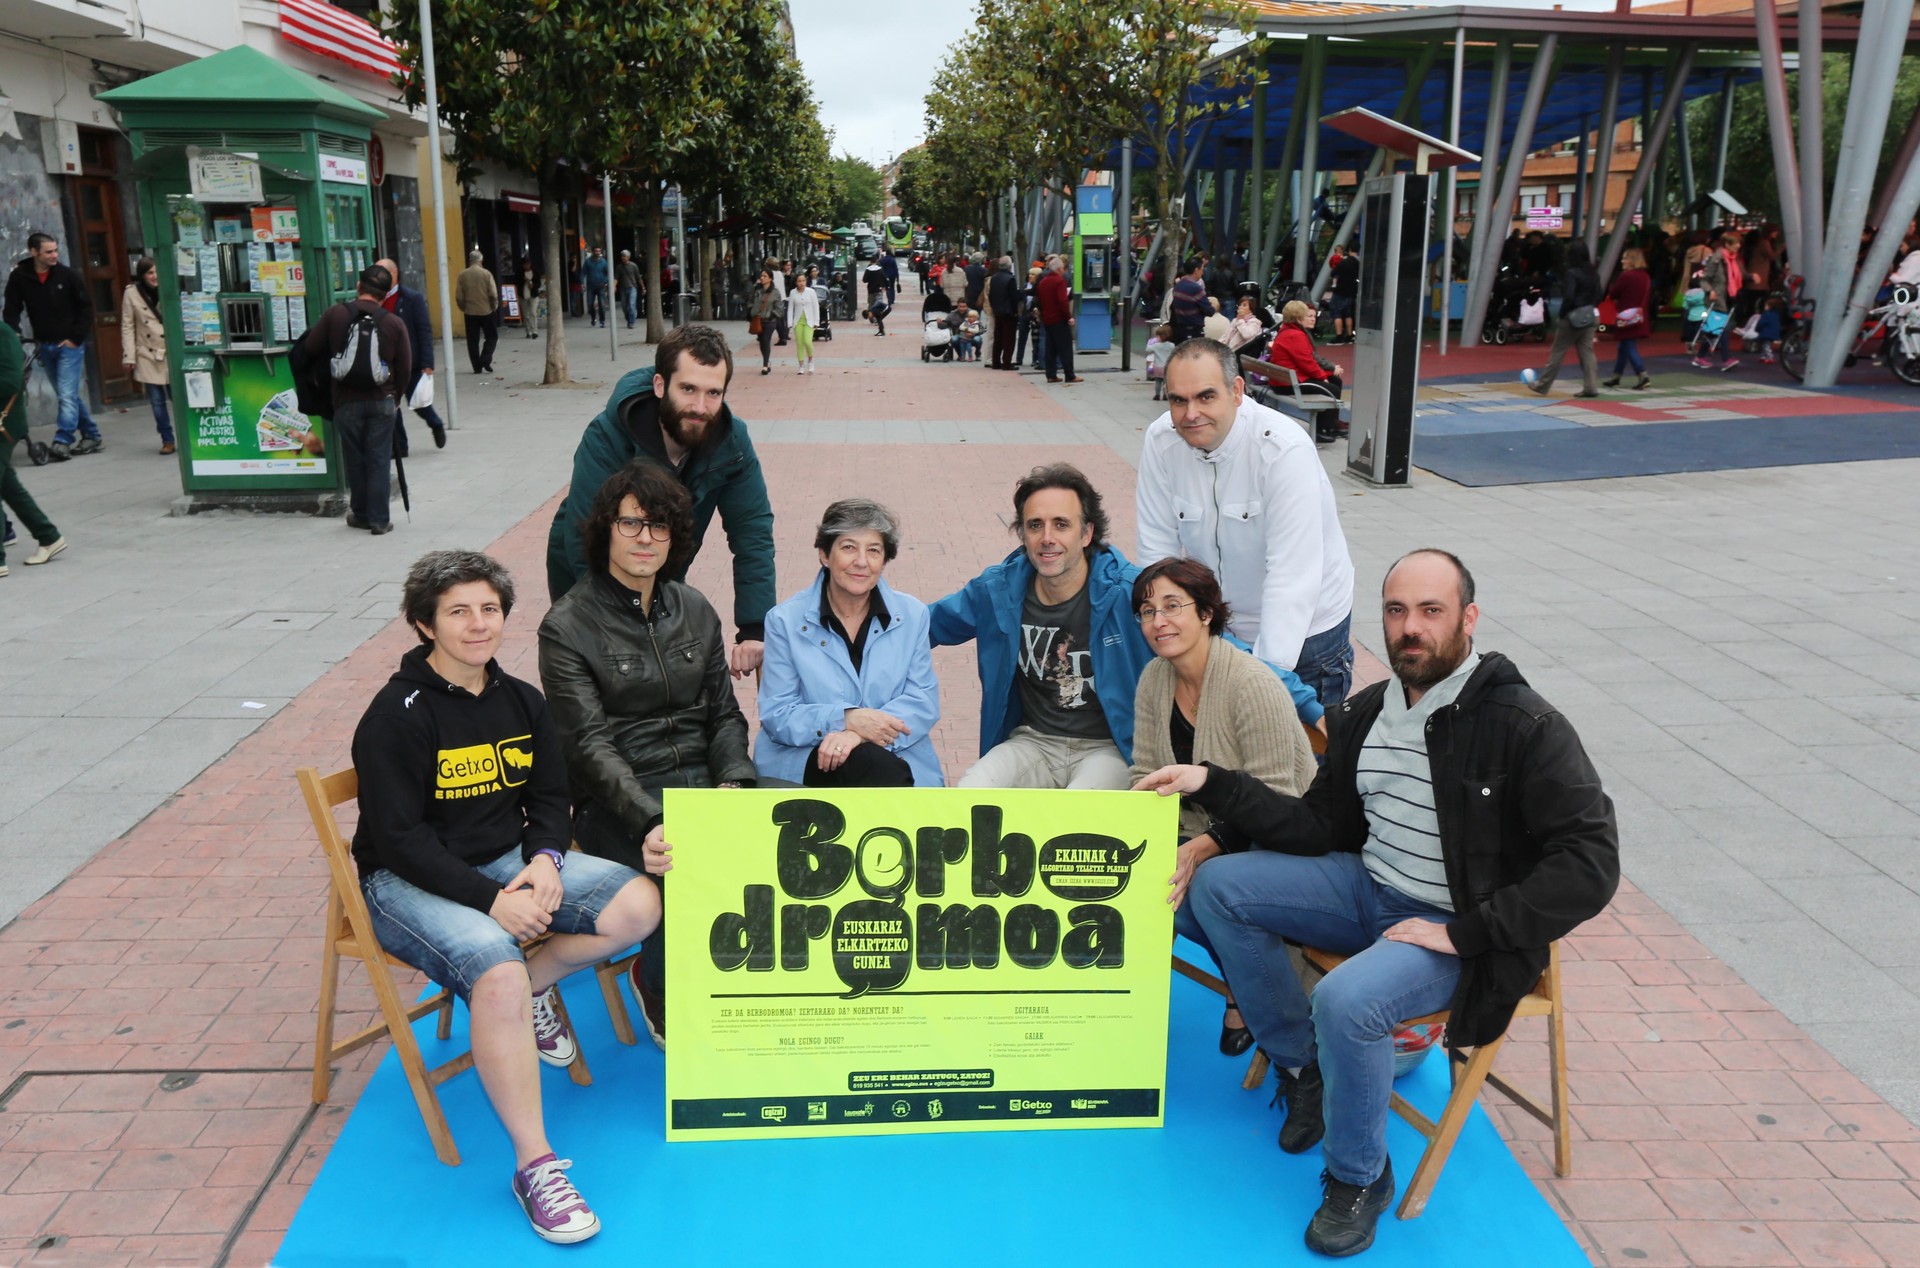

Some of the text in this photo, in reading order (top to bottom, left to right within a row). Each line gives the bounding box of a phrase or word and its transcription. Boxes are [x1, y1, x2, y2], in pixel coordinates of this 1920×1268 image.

[288, 267, 303, 281] 16
[200, 415, 234, 426] ACTIVAS
[199, 426, 236, 436] NUESTRO
[439, 757, 495, 779] Getxo
[435, 782, 502, 799] ERRUGBIA
[1055, 849, 1119, 864] EKAINAK 4
[843, 920, 903, 935] EUSKARAZ
[836, 937, 909, 952] ELKARTZEKO
[852, 955, 892, 969] GUNEA
[720, 1009, 733, 1017] ZER
[838, 1007, 850, 1015] DA?
[892, 1006, 904, 1014] DA?
[1014, 1006, 1049, 1014] EGITARAUA
[779, 1036, 845, 1046] NOLA EGINGO DUGU?
[1024, 1032, 1044, 1040] GAIAK
[1021, 1100, 1053, 1110] Getxo
